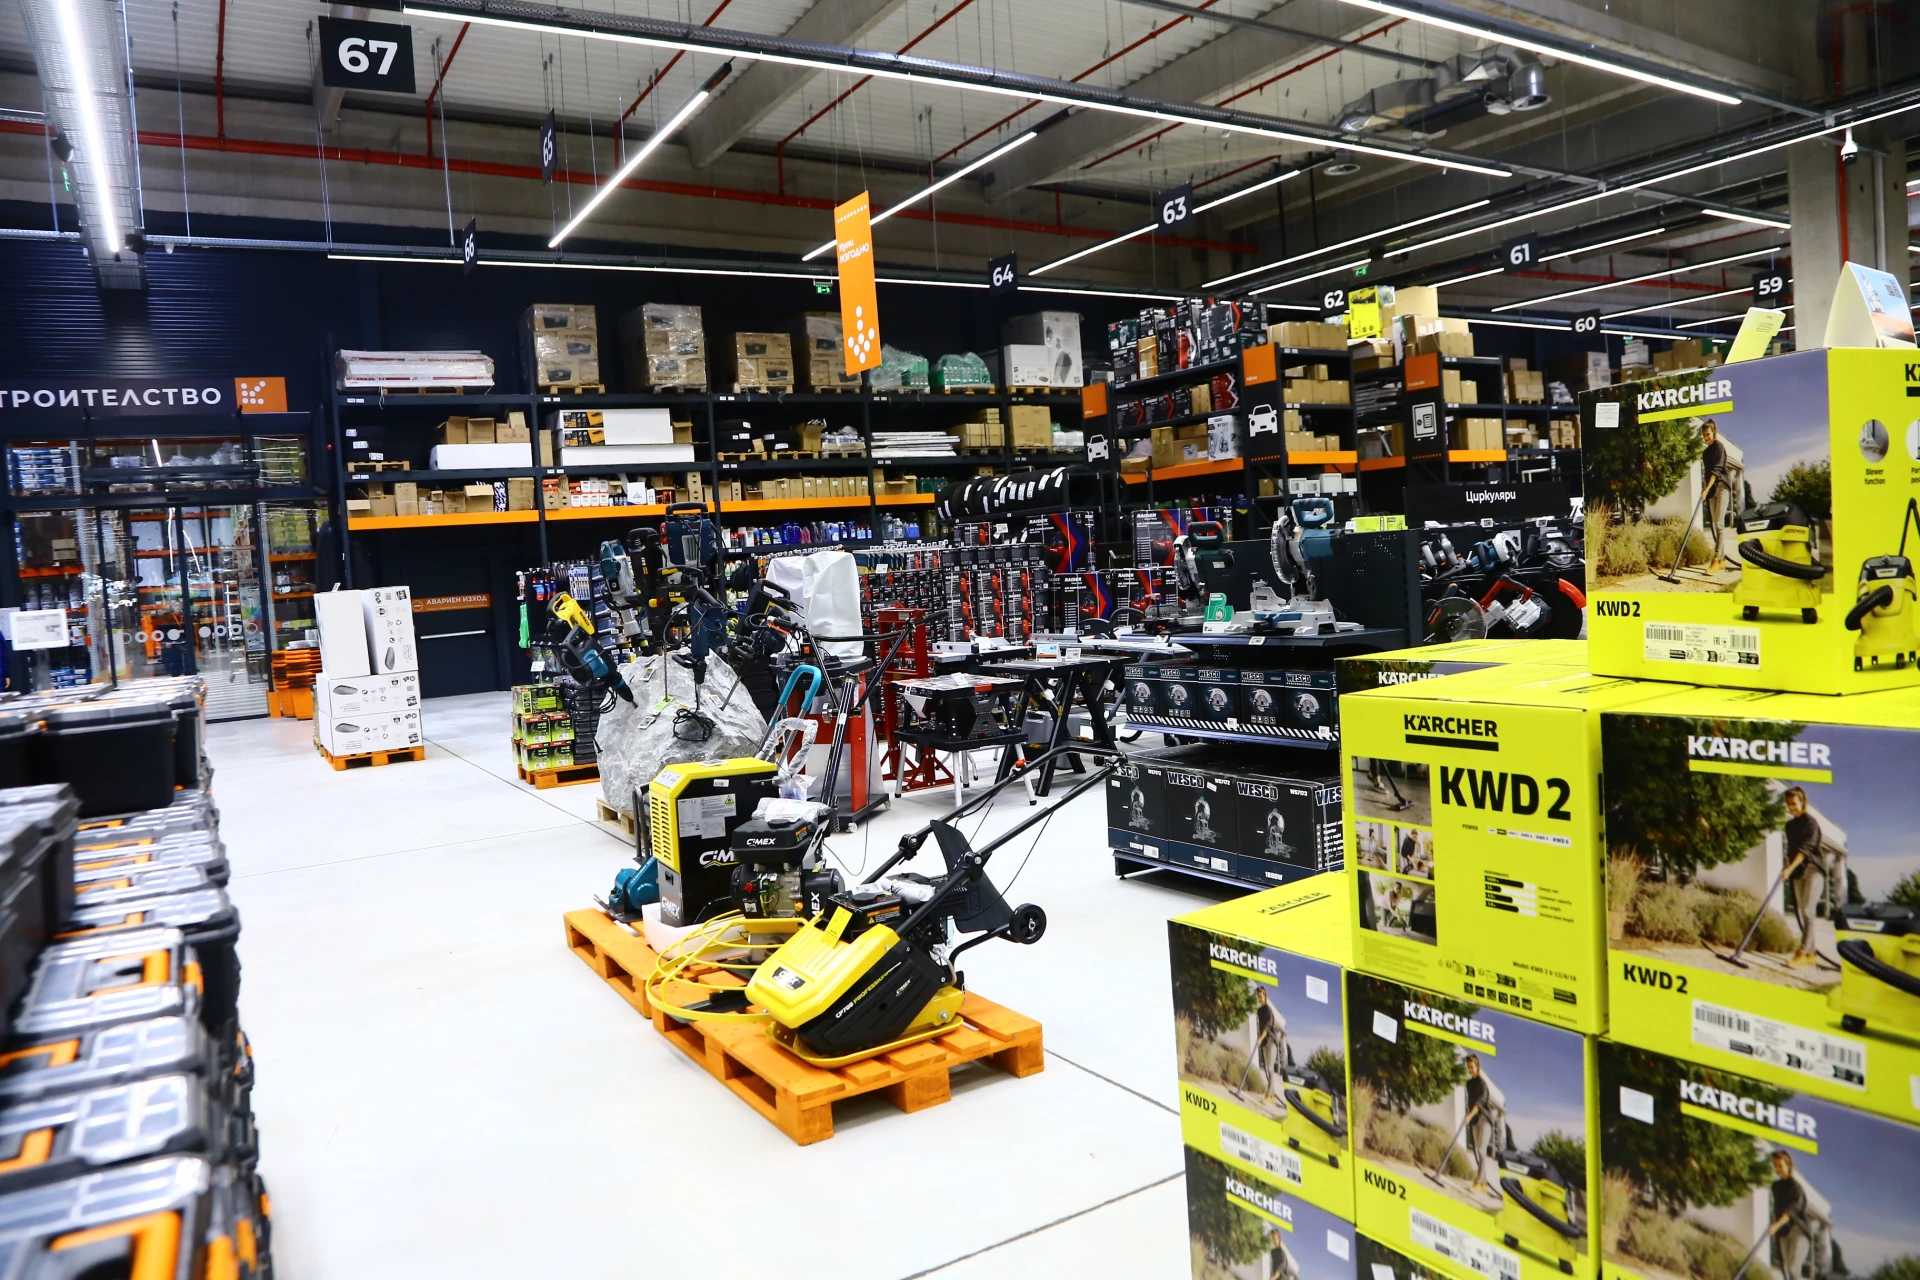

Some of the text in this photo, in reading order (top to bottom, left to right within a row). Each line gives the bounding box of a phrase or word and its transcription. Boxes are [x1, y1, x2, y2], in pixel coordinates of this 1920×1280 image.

[338, 37, 399, 76] 67
[543, 129, 553, 167] 65
[1163, 196, 1187, 224] 63
[463, 232, 474, 262] 66
[839, 239, 854, 252] Купи
[839, 243, 870, 264] ИЗГОДНО
[1509, 243, 1530, 265] 61
[992, 264, 1014, 287] 64
[1758, 276, 1783, 295] 59
[1323, 289, 1345, 309] 62
[1575, 316, 1596, 332] 60
[1637, 379, 1733, 411] KÄRCHER
[1864, 477, 1886, 486] function
[1865, 467, 1884, 476] Blower
[1465, 490, 1517, 504] Циркуляри
[426, 595, 488, 606] АВАРИЕН ИЗХОД
[1596, 601, 1641, 617] KWD 2
[1199, 670, 1220, 678] WESCO
[1241, 672, 1264, 680] WESCO
[1285, 674, 1311, 683] WESCO
[1378, 671, 1446, 685] KÄRCH
[1404, 714, 1498, 737] KÄRCHER
[1687, 735, 1832, 767] KÄRCHER
[1167, 772, 1204, 788] WESCO
[1237, 782, 1278, 800] WESCO
[1315, 786, 1343, 807] WES
[1440, 766, 1571, 822] KWD 2
[1265, 871, 1283, 881] 1800W
[1209, 943, 1278, 976] KÄRCHER
[1623, 963, 1688, 994] KWD 2
[1404, 1000, 1496, 1044] KÄRCHER
[1185, 1090, 1218, 1115] KWD 2
[1680, 1079, 1818, 1139] KÄRCHER
[1364, 1169, 1407, 1200] KWD 2
[1226, 1175, 1293, 1222] KÄRCHER
